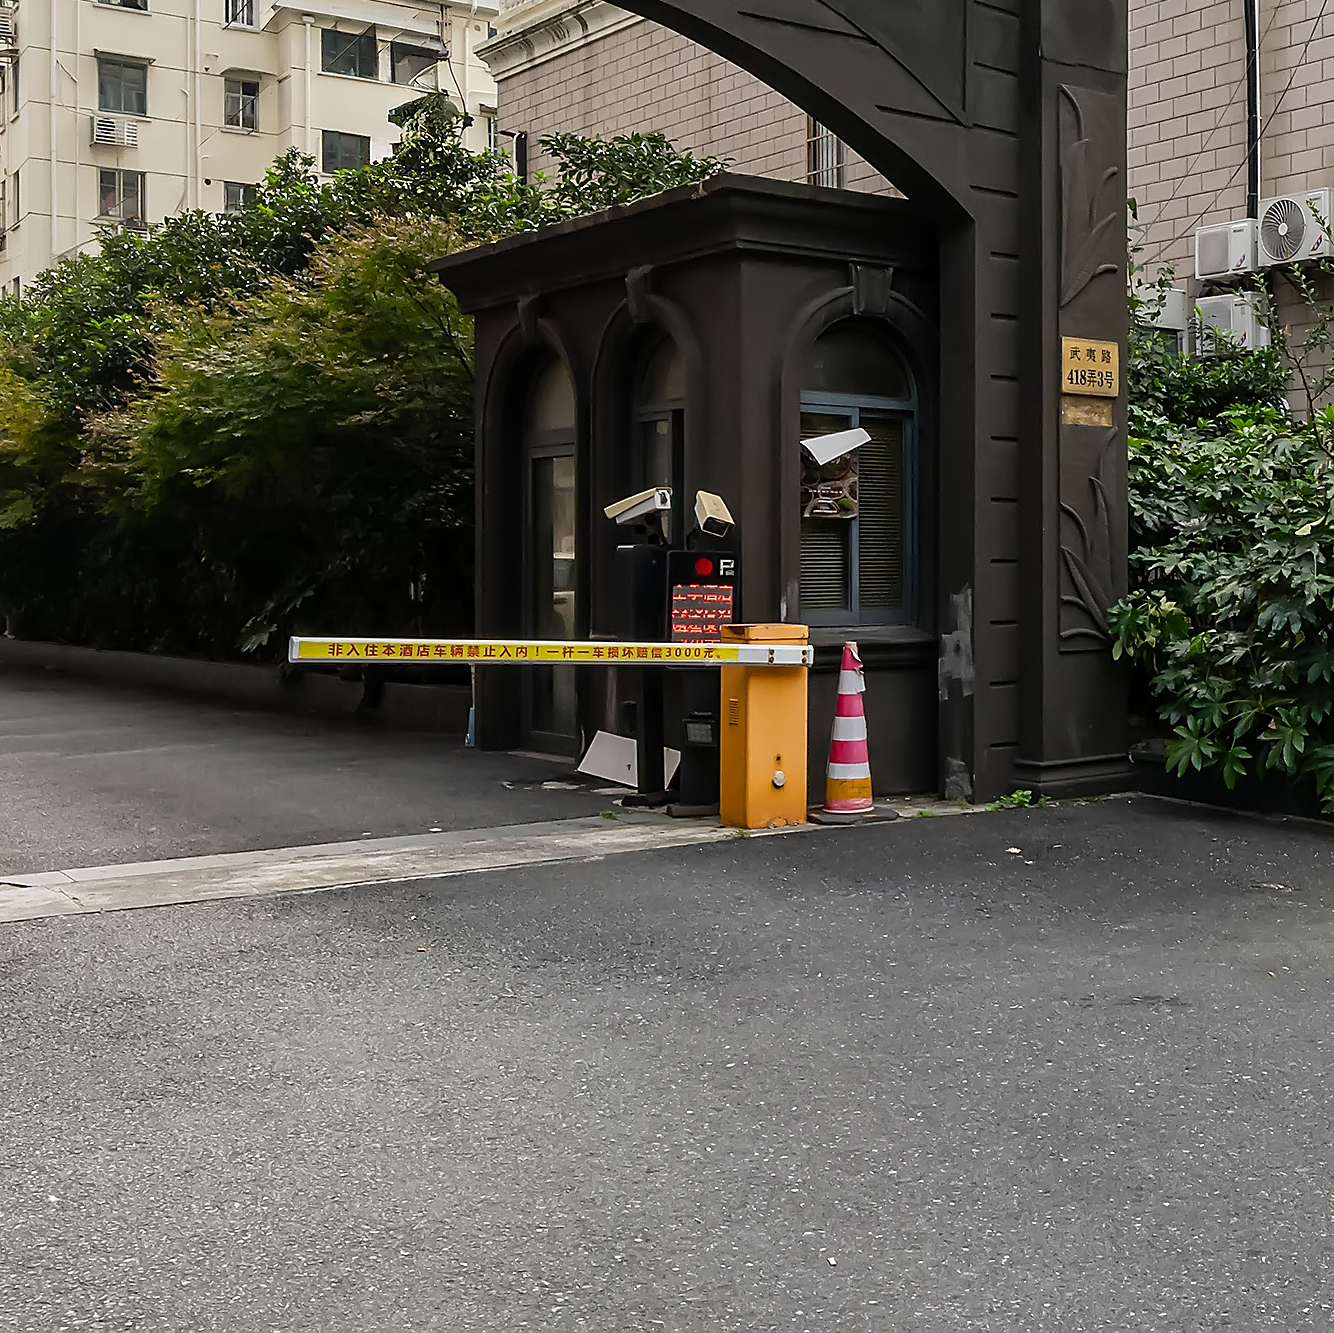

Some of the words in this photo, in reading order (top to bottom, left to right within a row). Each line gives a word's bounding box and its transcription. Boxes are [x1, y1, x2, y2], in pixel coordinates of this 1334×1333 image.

[1070, 346, 1112, 364] 武夷路
[1067, 369, 1115, 389] 418弄3号
